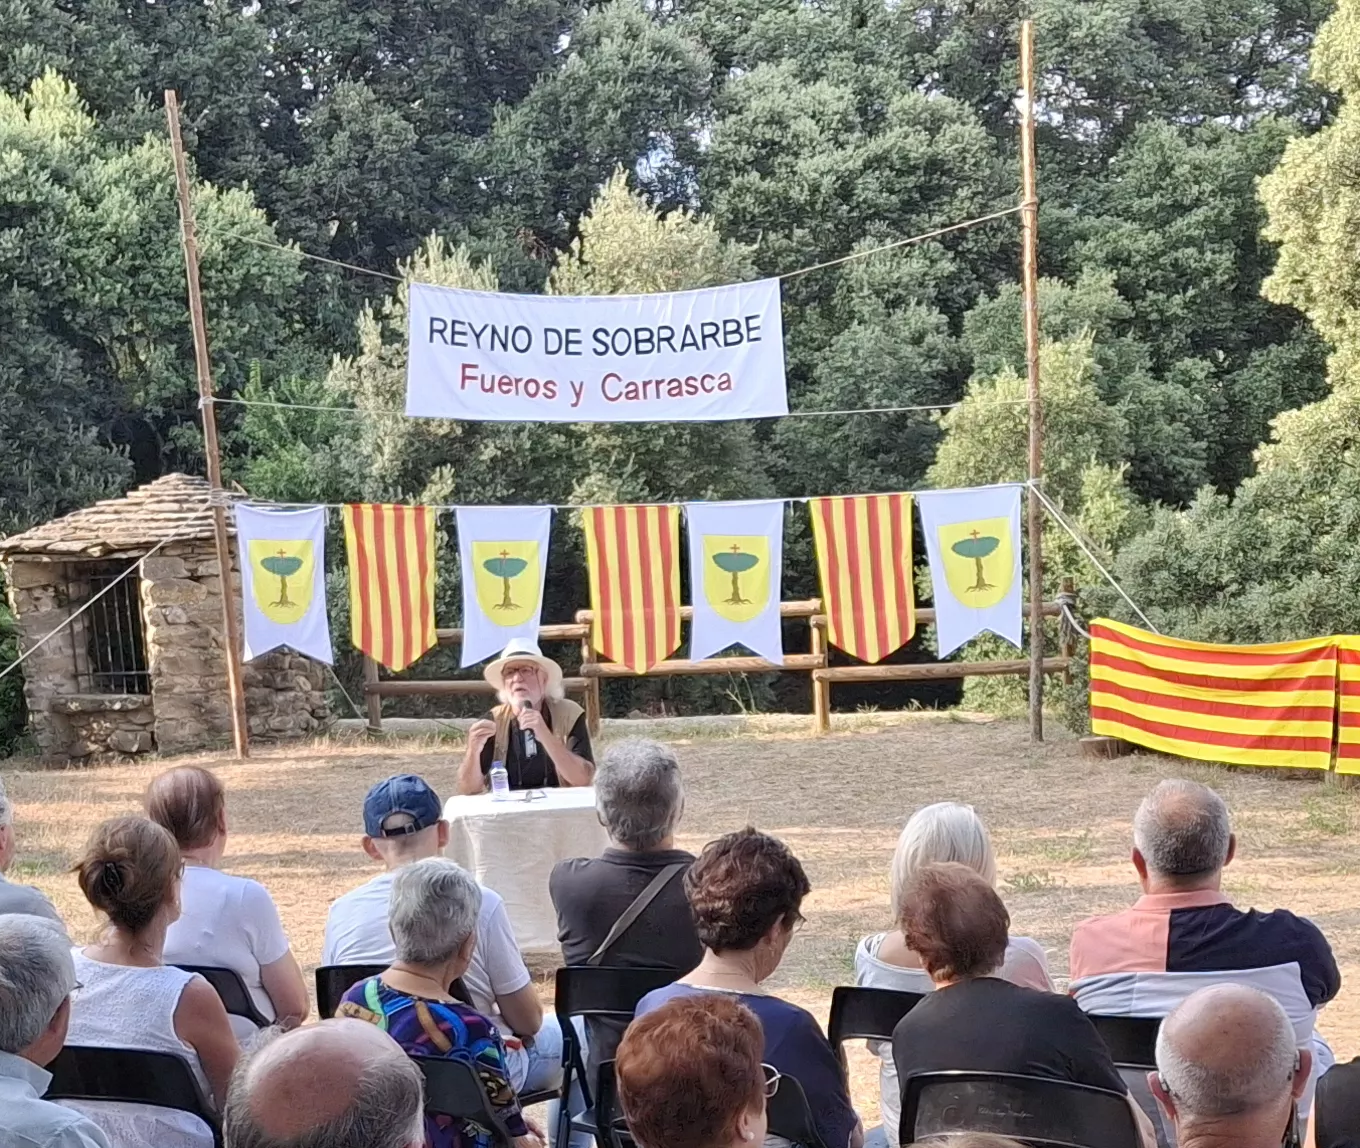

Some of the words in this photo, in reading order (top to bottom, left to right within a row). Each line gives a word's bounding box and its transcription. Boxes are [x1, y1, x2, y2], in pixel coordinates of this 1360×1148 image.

[428, 315, 533, 355] REYNO
[543, 327, 583, 357] DE
[591, 313, 763, 358] SOBRARBE
[459, 362, 558, 401] Fueros
[569, 380, 585, 408] y
[600, 370, 733, 403] Carrasca
